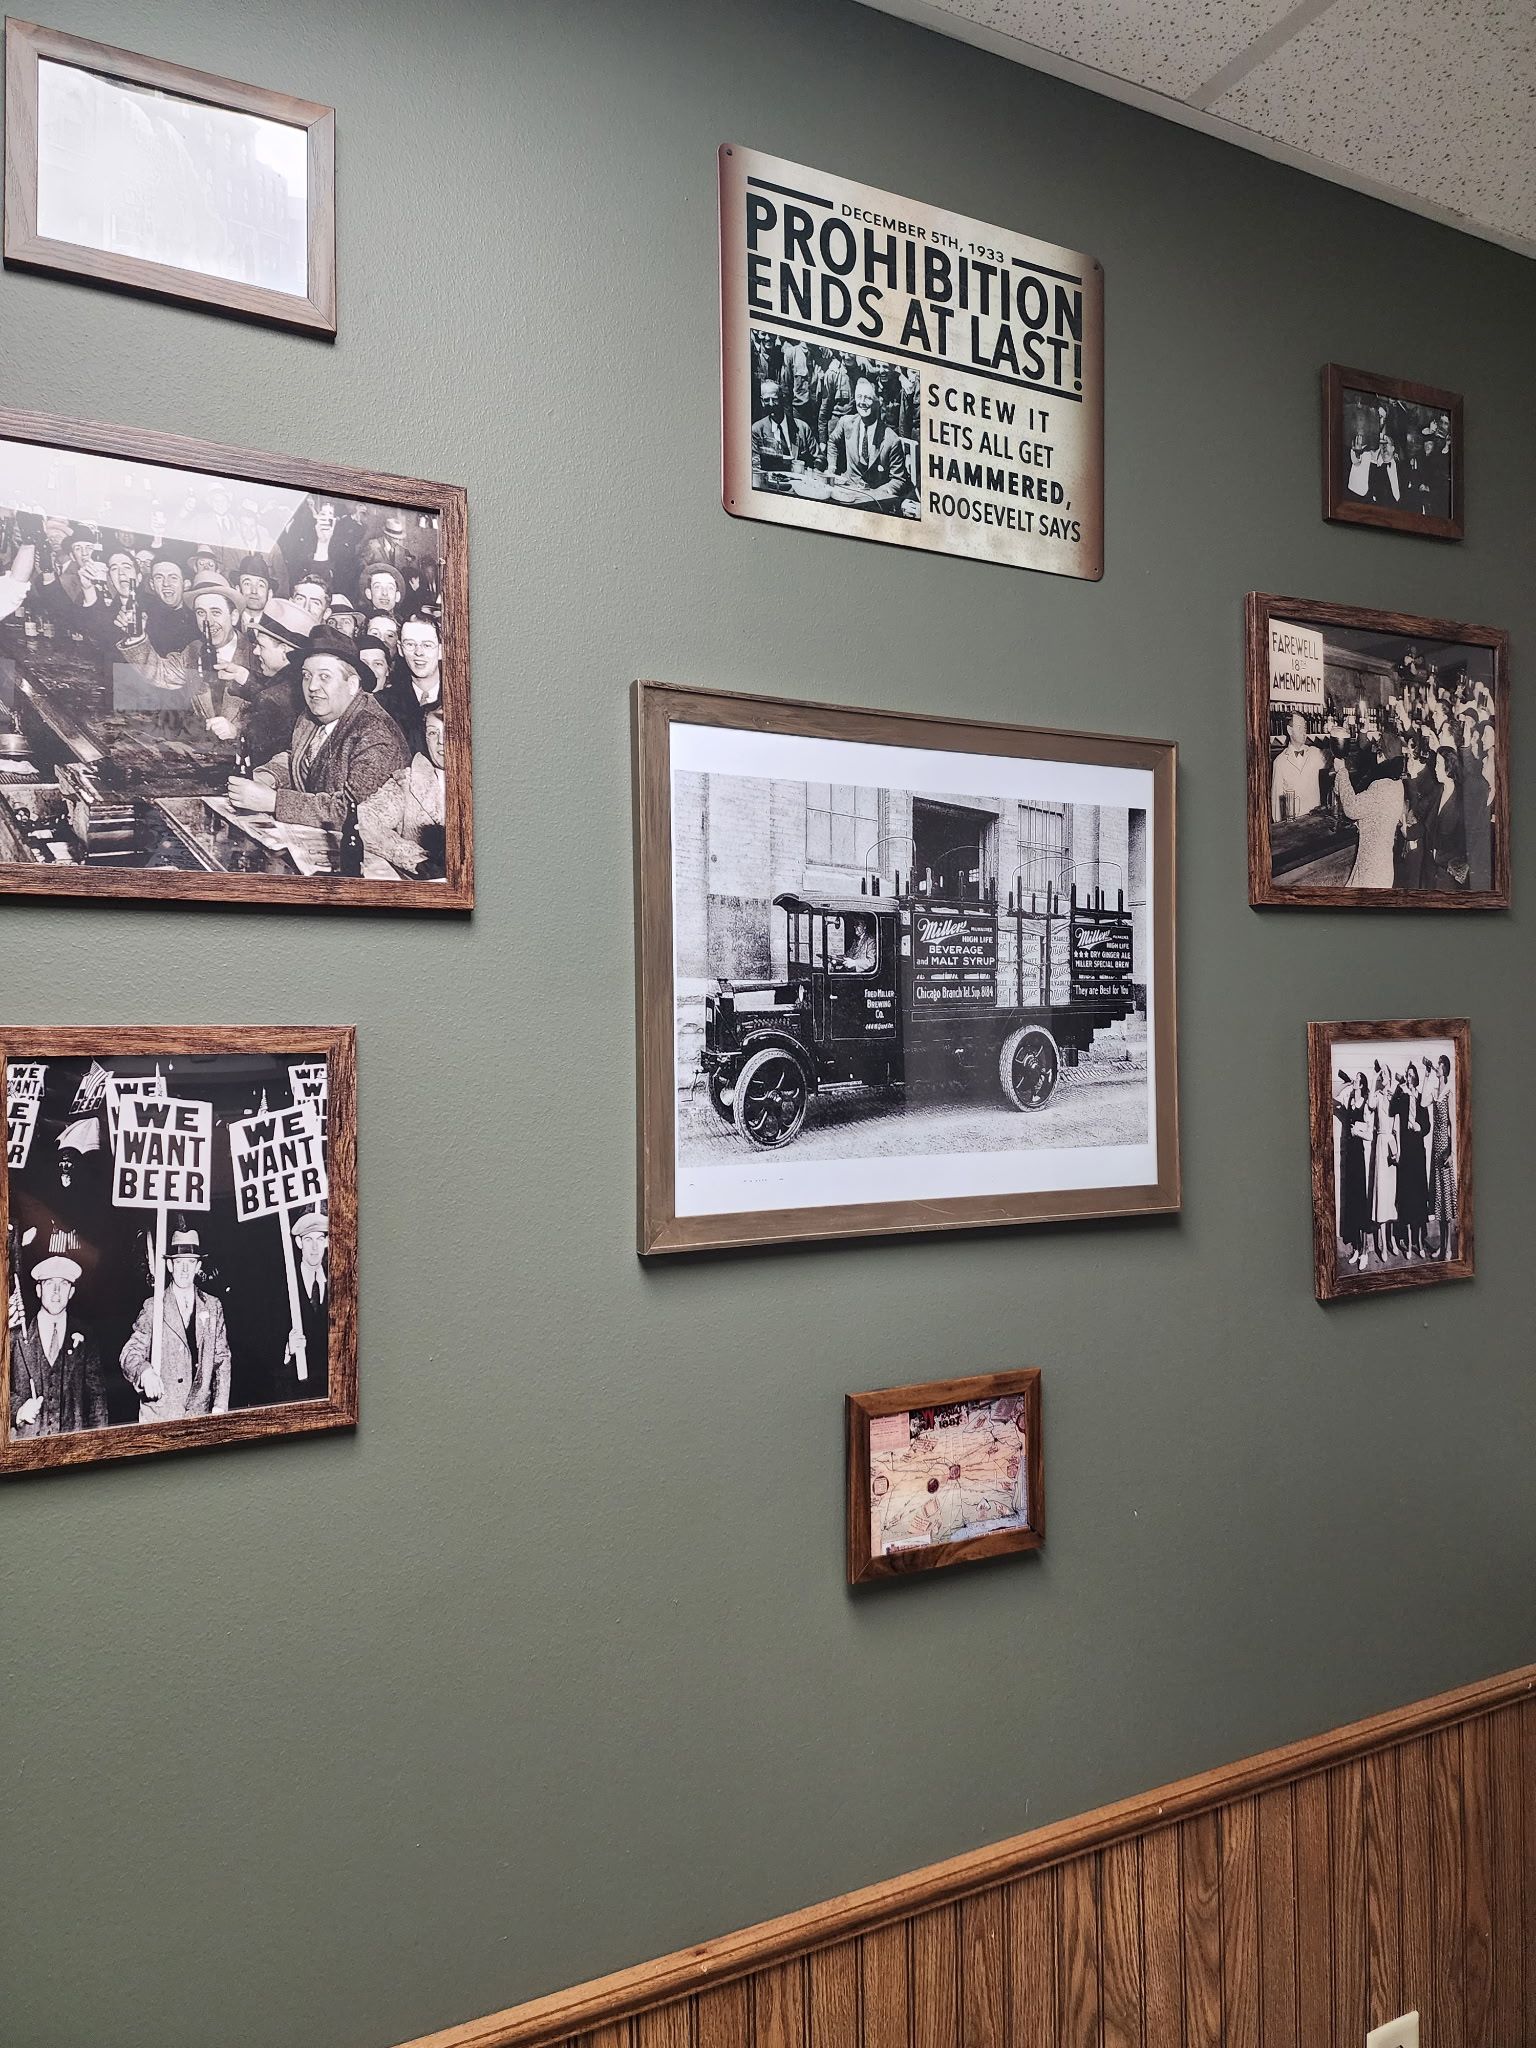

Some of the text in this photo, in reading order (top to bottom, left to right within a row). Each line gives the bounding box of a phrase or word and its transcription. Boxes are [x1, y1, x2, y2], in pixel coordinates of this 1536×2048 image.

[842, 203, 1004, 263] DECEMBER 5TH, 1933
[746, 192, 1083, 342] PROHIBITION
[747, 252, 1083, 392] ENDS AT LAST!
[928, 383, 1049, 433] SCREW IT
[928, 418, 1054, 469] LETS ALL GET
[928, 453, 1071, 511] HAMMERED,
[929, 491, 1081, 543] ROOSEVELT SAYS
[1271, 631, 1319, 660] FAREWELL
[1272, 672, 1321, 693] AMENDMENT
[929, 945, 984, 955] BEVERAGE
[961, 935, 978, 944] HIGH
[979, 935, 994, 944] LIFE
[1090, 950, 1131, 960] DRY GINGER ALE
[916, 956, 996, 966] and MALT SYRUP
[1075, 960, 1130, 969] MILLER SPECIAL BREW
[916, 986, 941, 1002] Chicago
[942, 986, 962, 999] Branch
[1088, 986, 1099, 995] are
[1099, 984, 1112, 995] Best
[13, 1067, 40, 1079] WE
[71, 1097, 102, 1112] BEER
[134, 1101, 199, 1132] WE
[242, 1111, 306, 1148] WE
[123, 1130, 205, 1167] WANT
[237, 1135, 314, 1182] WANT
[118, 1167, 205, 1203] BEER
[240, 1167, 322, 1214] BEER
